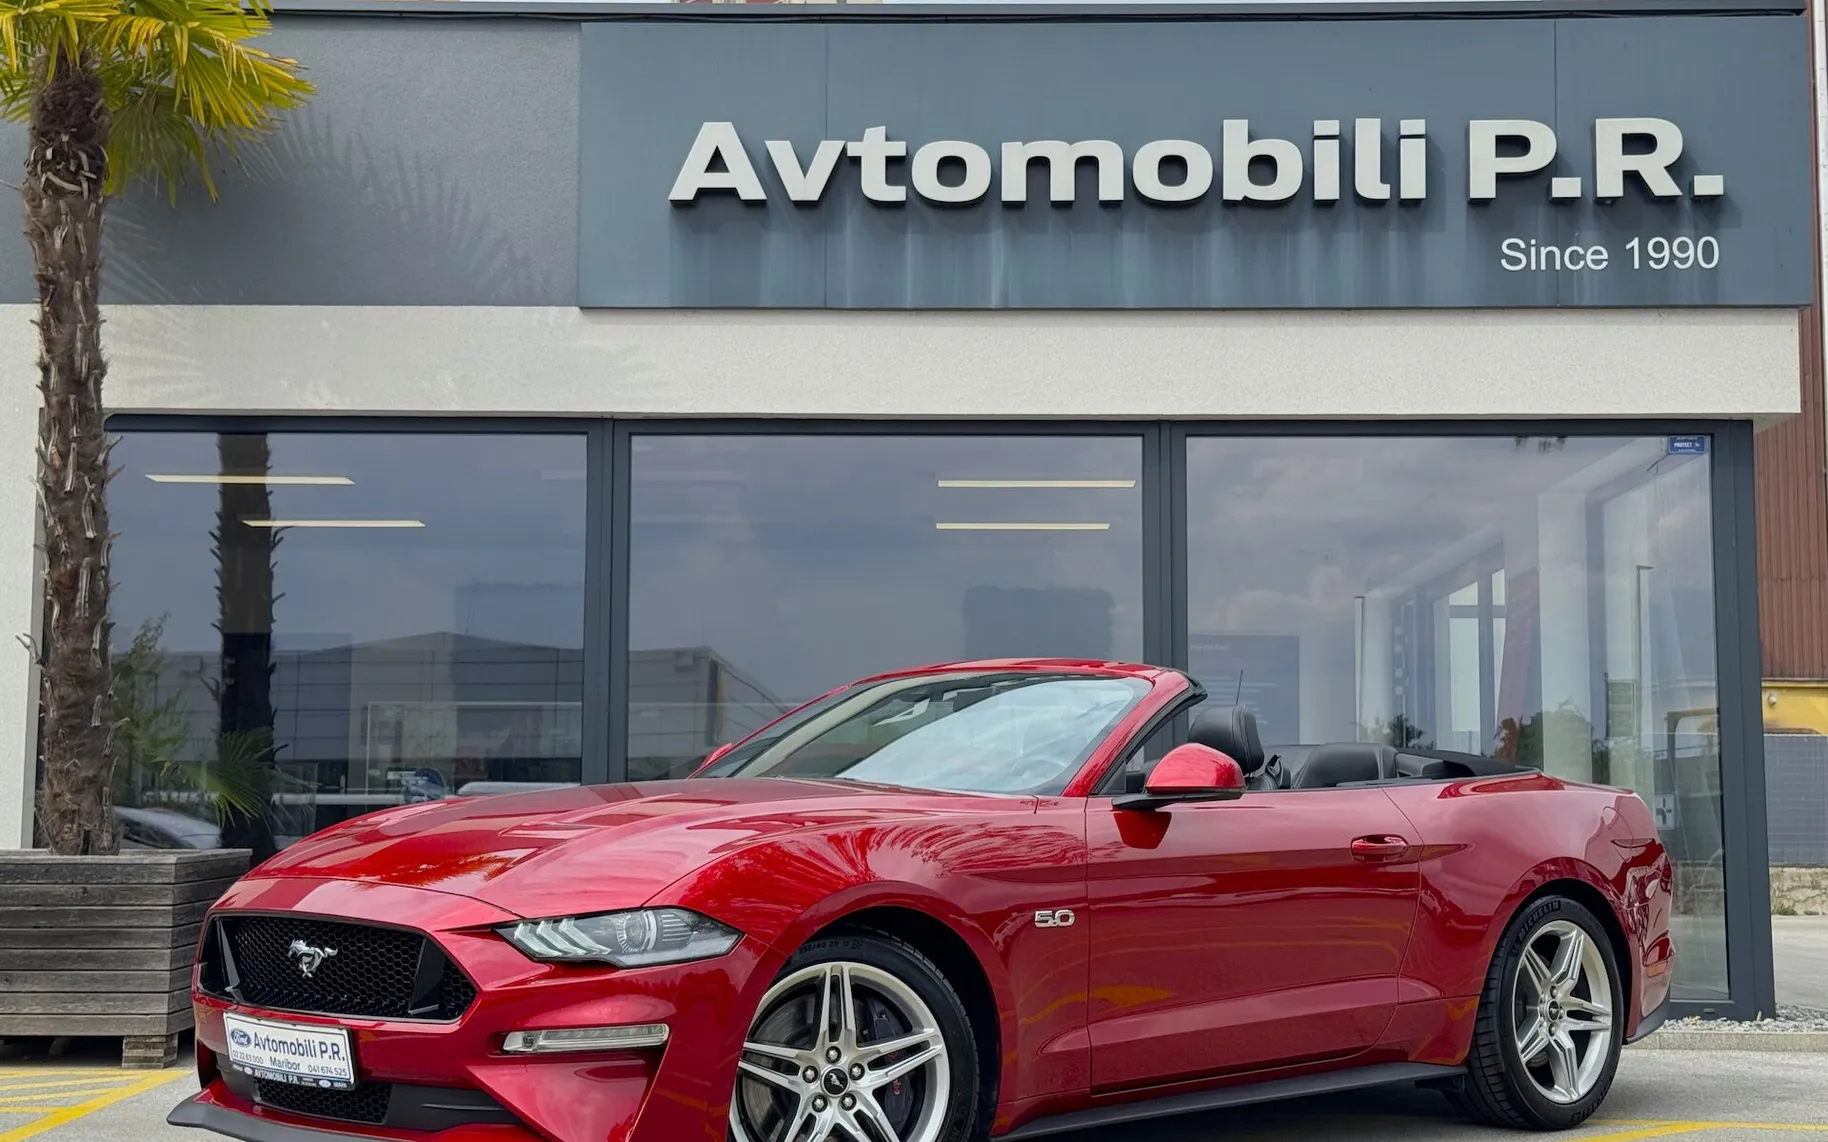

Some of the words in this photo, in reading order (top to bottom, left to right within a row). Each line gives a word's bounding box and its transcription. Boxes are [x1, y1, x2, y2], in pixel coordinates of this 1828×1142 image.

[669, 118, 1426, 203] Avtomobili
[1467, 118, 1725, 202] P.R.
[1501, 236, 1609, 271] Since
[1626, 235, 1720, 270] 1990
[1035, 909, 1075, 927] 5.0
[1518, 900, 1560, 941] MICHELIN
[232, 1029, 250, 1046] Ford
[254, 1031, 317, 1058] Avtomobili
[318, 1041, 346, 1062] P.R.
[254, 1069, 287, 1082] AVTOMOBILI
[269, 1056, 301, 1071] Maribor
